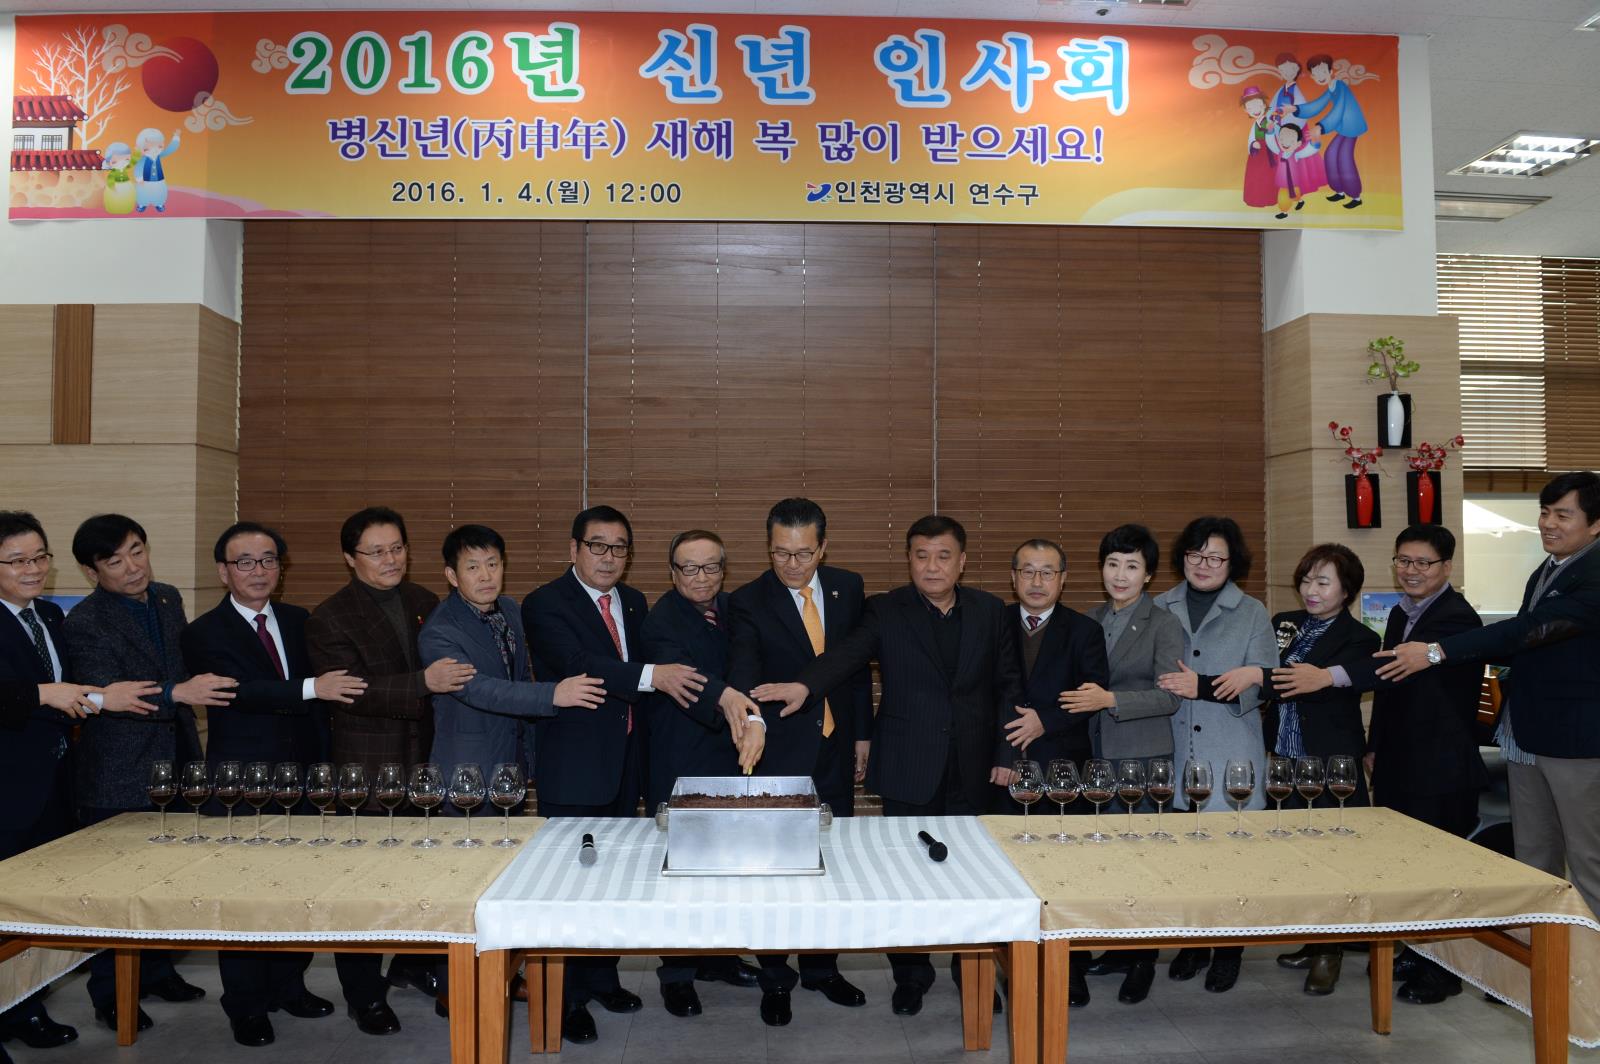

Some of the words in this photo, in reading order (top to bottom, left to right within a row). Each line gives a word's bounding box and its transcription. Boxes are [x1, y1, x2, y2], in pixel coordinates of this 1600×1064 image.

[287, 24, 584, 101] 2016년
[642, 25, 814, 103] 신년
[875, 29, 1128, 112] 인사회
[328, 117, 627, 160] 병신년(丙申年)
[647, 119, 733, 160] 새해
[754, 121, 796, 161] 복
[817, 120, 900, 164] 많이
[921, 121, 1104, 166] 받으세요!
[392, 181, 464, 203] 2016.
[481, 182, 503, 203] 1.
[518, 180, 590, 206] 4.(월)
[605, 182, 681, 203] 12:00
[835, 180, 955, 205] 인천광역시
[969, 182, 1040, 206] 연수구
